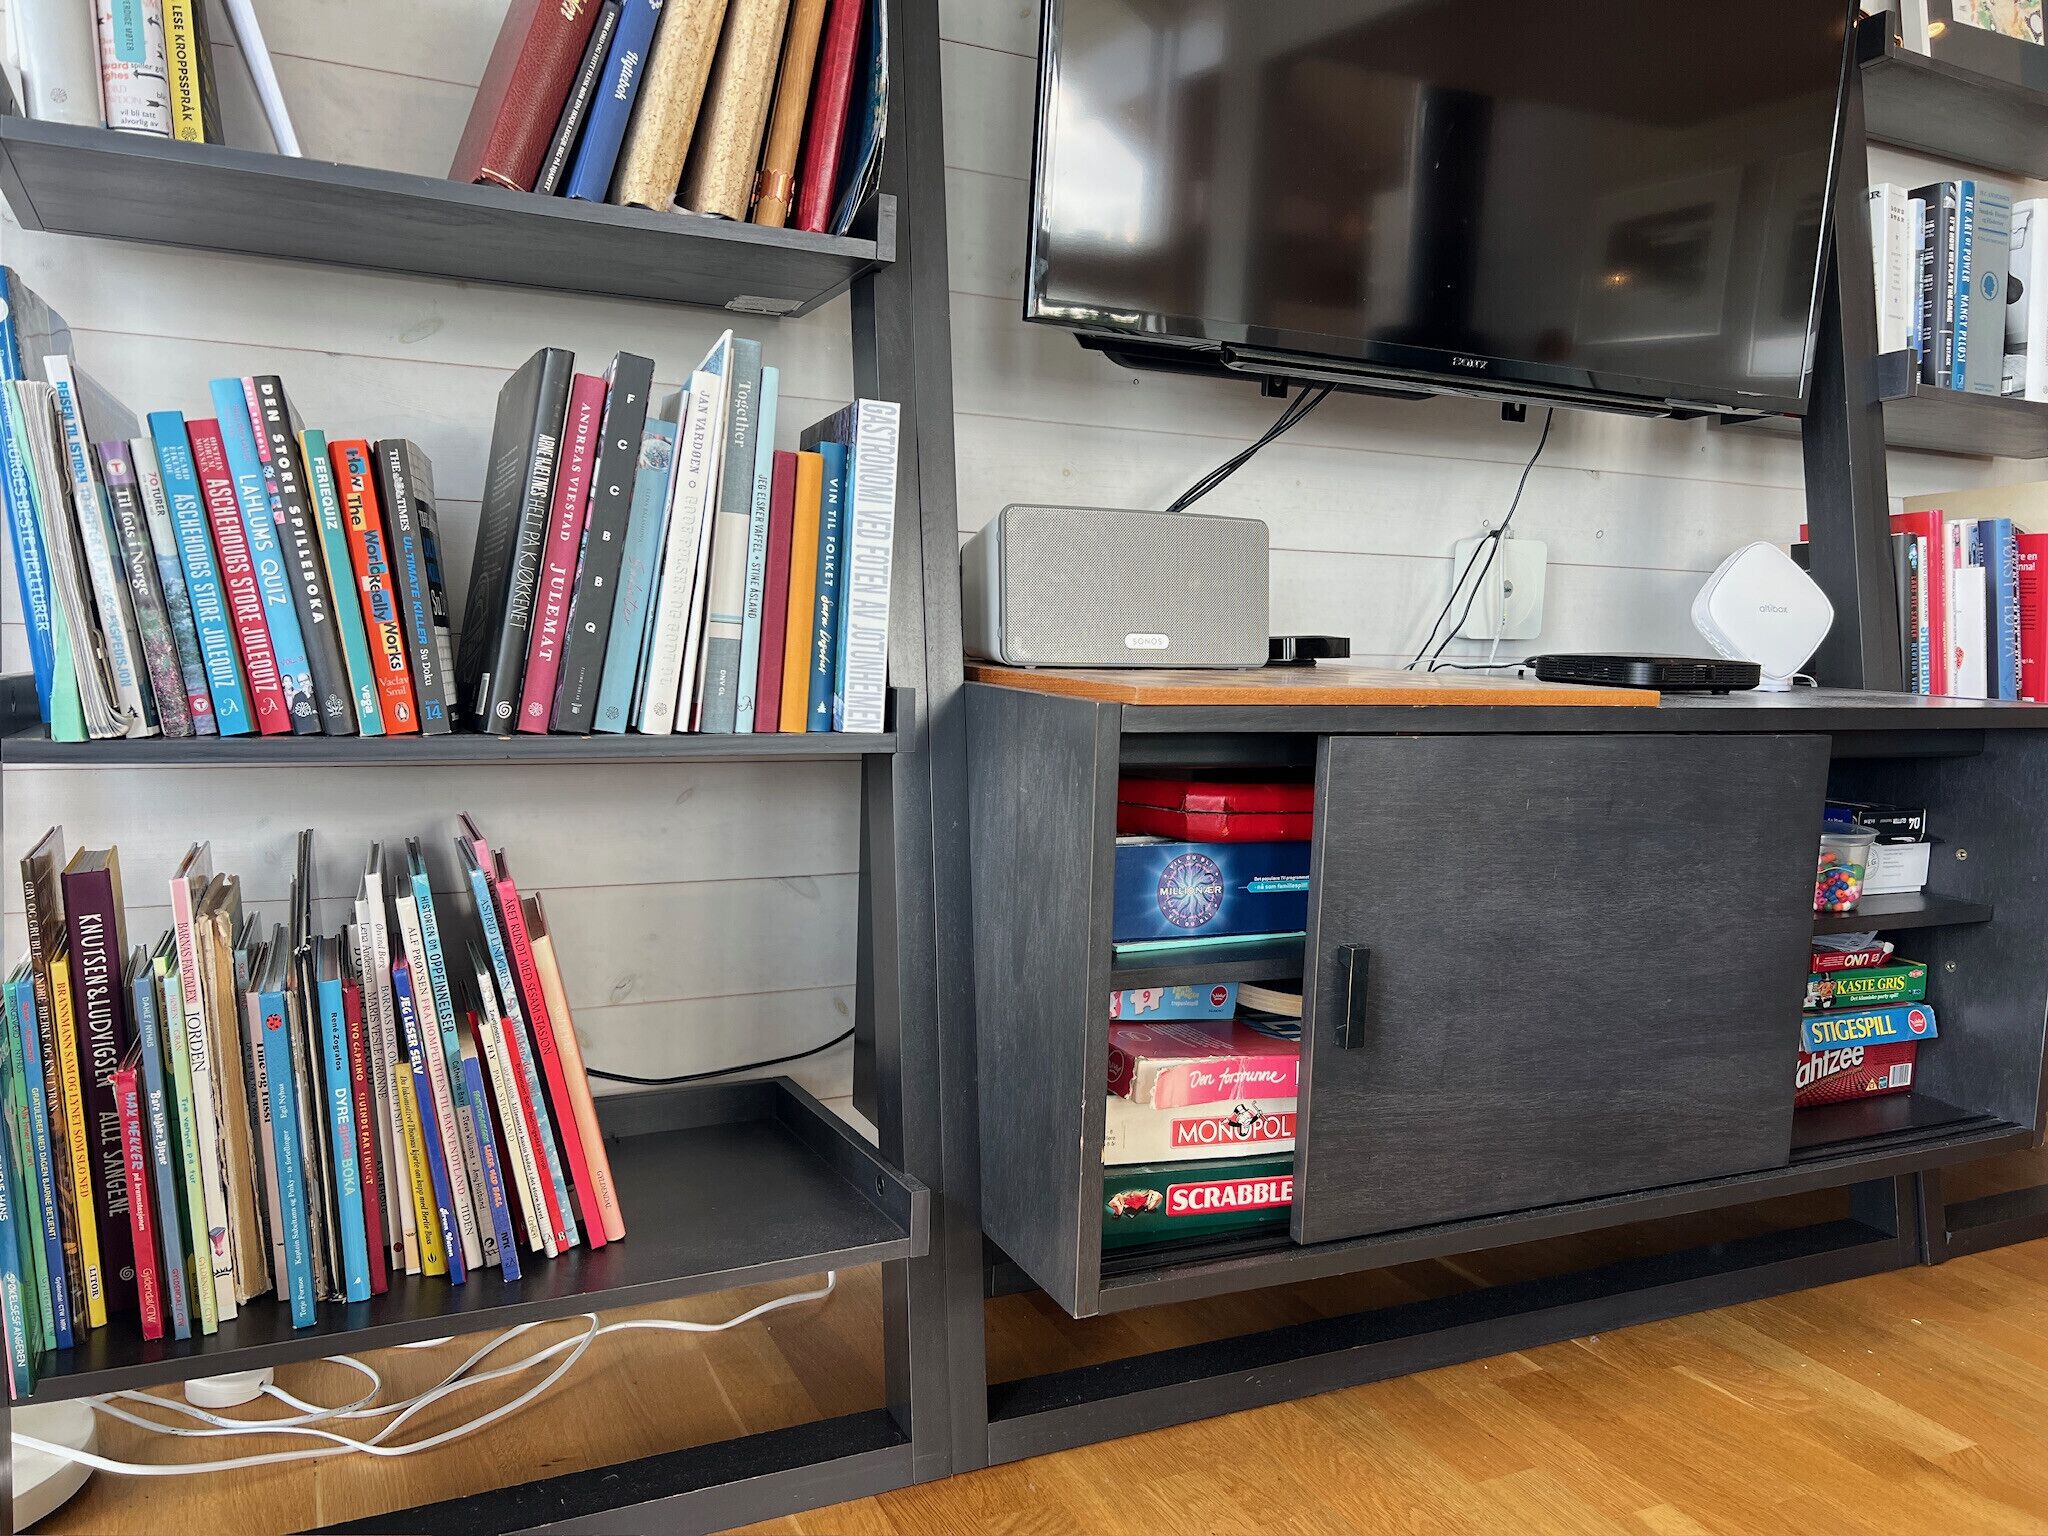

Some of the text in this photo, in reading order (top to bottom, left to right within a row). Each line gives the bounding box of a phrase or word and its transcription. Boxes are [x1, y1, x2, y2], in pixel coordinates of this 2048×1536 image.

[171, 4, 195, 121] LESE KROPPSSPRÅK
[613, 49, 639, 100] Hyllebok
[1963, 216, 1972, 235] ART
[1964, 195, 1973, 213] THE
[1961, 248, 1971, 283] POWER
[1958, 294, 1969, 326] NANCY
[1956, 330, 1967, 362] PELOSI
[56, 380, 87, 483] REISEN TIL ISTIDEN
[688, 389, 710, 474] JAN VARDØEN
[729, 379, 753, 448] Together
[117, 488, 131, 508] Til
[151, 487, 166, 516] TURER
[260, 382, 326, 624] DEN STORE SPILLEBOKA
[312, 455, 338, 530] FERIEQUIZ
[346, 493, 366, 526] The
[16, 499, 35, 544] BESTE
[122, 510, 138, 538] fots
[204, 474, 250, 575] ASCHEHOUGS
[238, 472, 274, 552] LAHLUMS
[258, 556, 287, 607] QUIZ
[508, 433, 555, 630] ARNE HJELTNES HELT PÅ KJØKKENET
[535, 402, 592, 660] ANDREAS VIESTAD JULEMAT
[822, 478, 838, 587] VIN TIL FOLKET
[362, 528, 386, 574] World
[388, 447, 433, 686] THE TIMES ULTIMATE KILLER Su Doku
[747, 474, 768, 618] JEG ELSKER VAFFEL STINE ÅSLAND
[844, 403, 898, 730] GASTRONOMI VED FOTEN AV JOTUNHEIMEN
[126, 550, 151, 597] Norge
[172, 491, 235, 689] ASCHEHOUGS STORE JULEQUIZ
[229, 574, 261, 624] STORE
[365, 573, 391, 622] Really
[239, 623, 278, 695] JULEQUIZ
[380, 621, 405, 670] Works
[426, 704, 442, 720] 14
[1160, 886, 1222, 896] MILLIONÆR
[22, 880, 42, 959] GRY OG GRUBLE
[359, 921, 371, 943] Lena
[77, 913, 107, 984] KNUTSEN
[361, 944, 376, 983] Anderson
[419, 894, 455, 1033] HISTORIEN OM OPPFINNELSER
[478, 898, 512, 991] ASTRID LINDGREN
[503, 895, 553, 1056] ÅRET RUNDT MED SESAM STASJON
[1142, 990, 1150, 1003] 9
[1836, 976, 1905, 994] KASTE GRIS
[55, 982, 72, 1049] BRANNMANN
[366, 991, 379, 1023] MARIS
[1812, 1014, 1896, 1044] STIGESPILL
[184, 1011, 206, 1073] JORDEN
[350, 1022, 365, 1081] IVO CAPRINO
[370, 1023, 383, 1055] VESLE
[398, 994, 424, 1076] JEG LESER SELV
[63, 1051, 75, 1074] SAM
[66, 1076, 77, 1091] OG
[374, 1056, 388, 1100] GRØNNE
[407, 926, 474, 1236] ALF PRØYSEN FRA HOMPETITTEN TIL BAKVENDTLAND TIDEN
[1190, 1069, 1214, 1088] Den
[30, 1086, 44, 1133] GRATULERER
[68, 1094, 82, 1126] LYNET
[179, 1097, 189, 1112] Tre
[485, 1044, 515, 1143] FLY PAUL STICKLAND
[36, 1134, 46, 1150] MED
[72, 1128, 84, 1152] SOM
[181, 1116, 193, 1148] venner
[38, 1152, 50, 1176] DAGEN
[97, 1110, 129, 1217] ALLE SANGENE
[188, 1169, 196, 1184] tur
[41, 1177, 53, 1205] BJARNE
[78, 1176, 90, 1198] NED
[595, 1170, 612, 1209] GYLDENDAL
[1172, 1180, 1292, 1211] SCRABBLE
[5, 1271, 27, 1367] SPØKELSESFANGEREN
